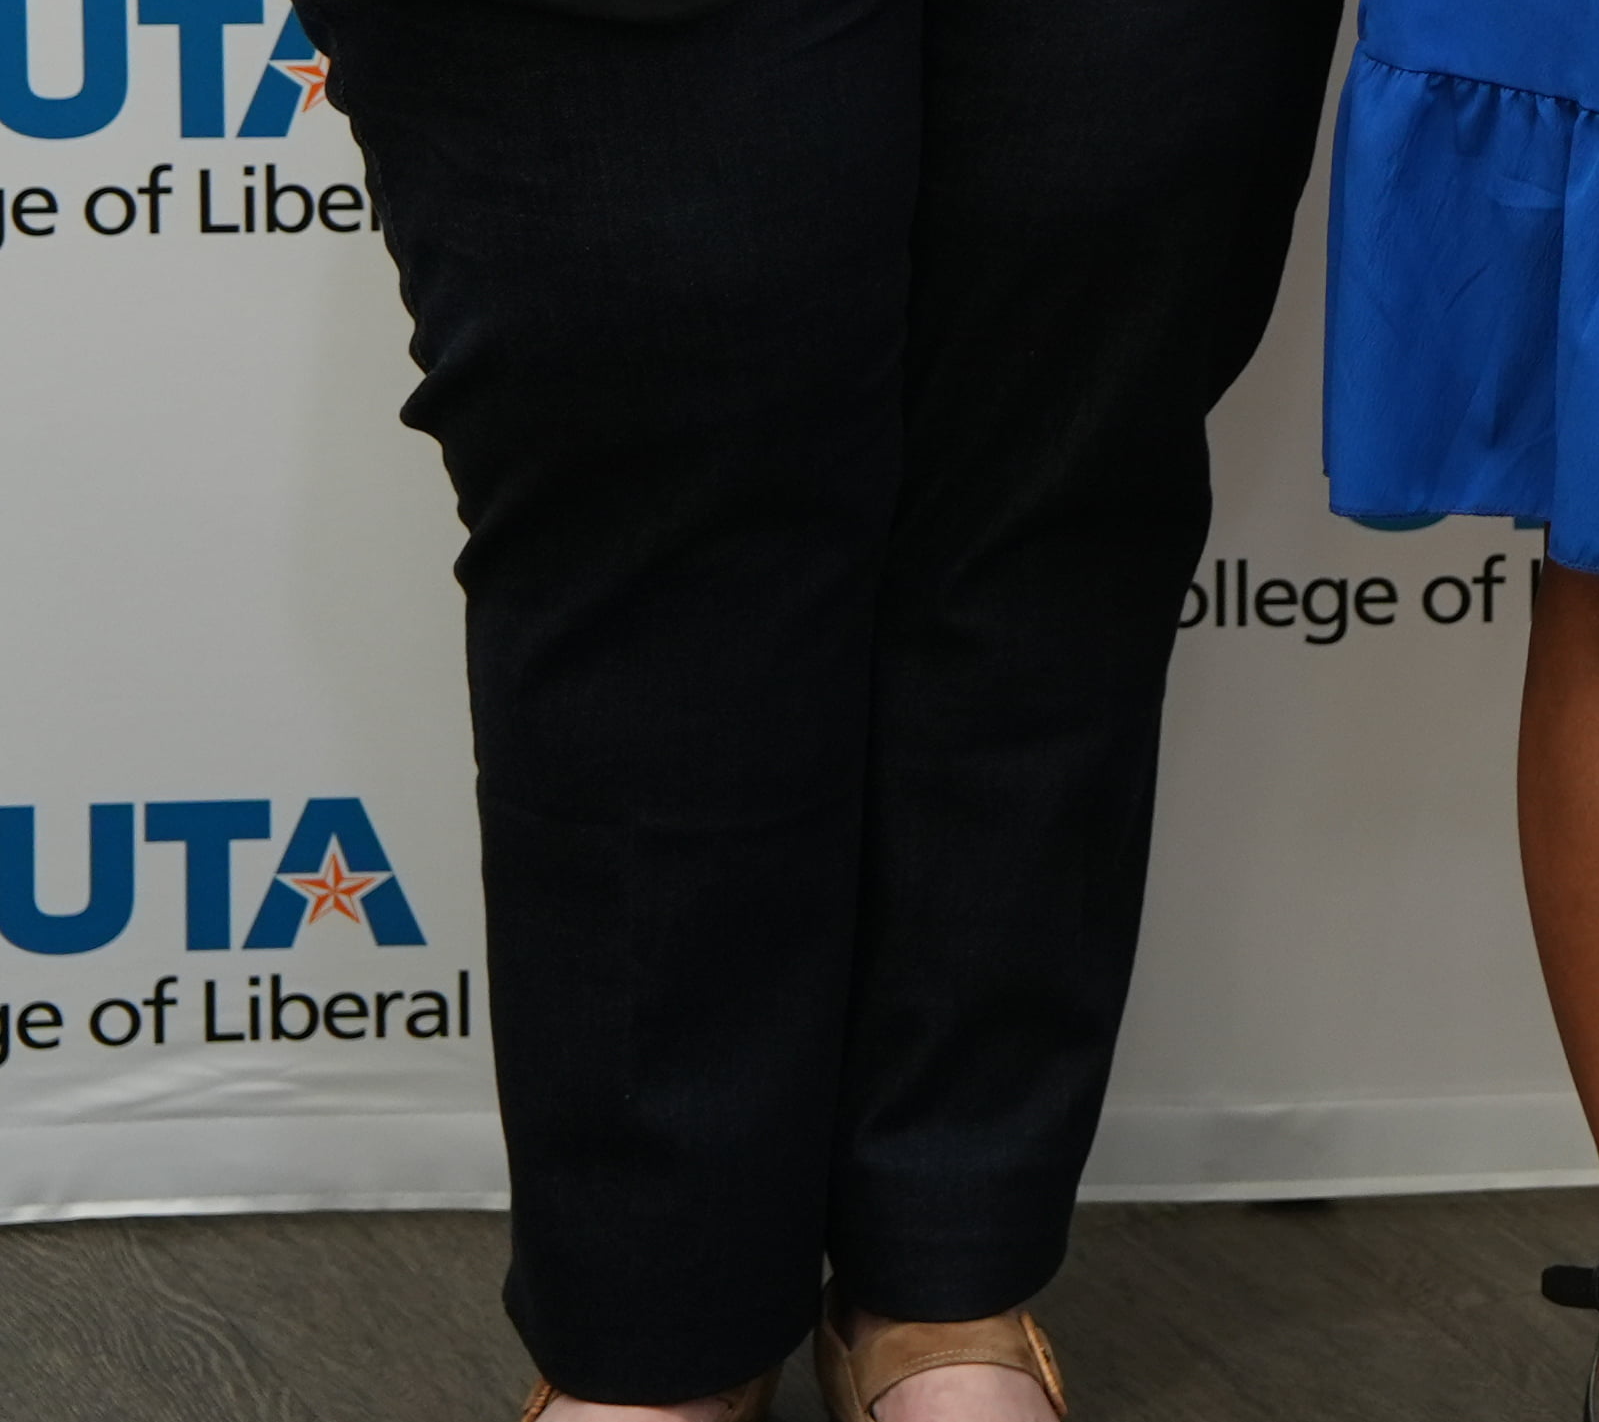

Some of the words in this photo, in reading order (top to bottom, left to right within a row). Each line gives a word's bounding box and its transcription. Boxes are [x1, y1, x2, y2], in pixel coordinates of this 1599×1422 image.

[84, 164, 173, 235] of
[1422, 554, 1506, 623] of
[0, 797, 427, 955] UTA
[90, 975, 178, 1047] of
[204, 969, 470, 1042] Liberal
